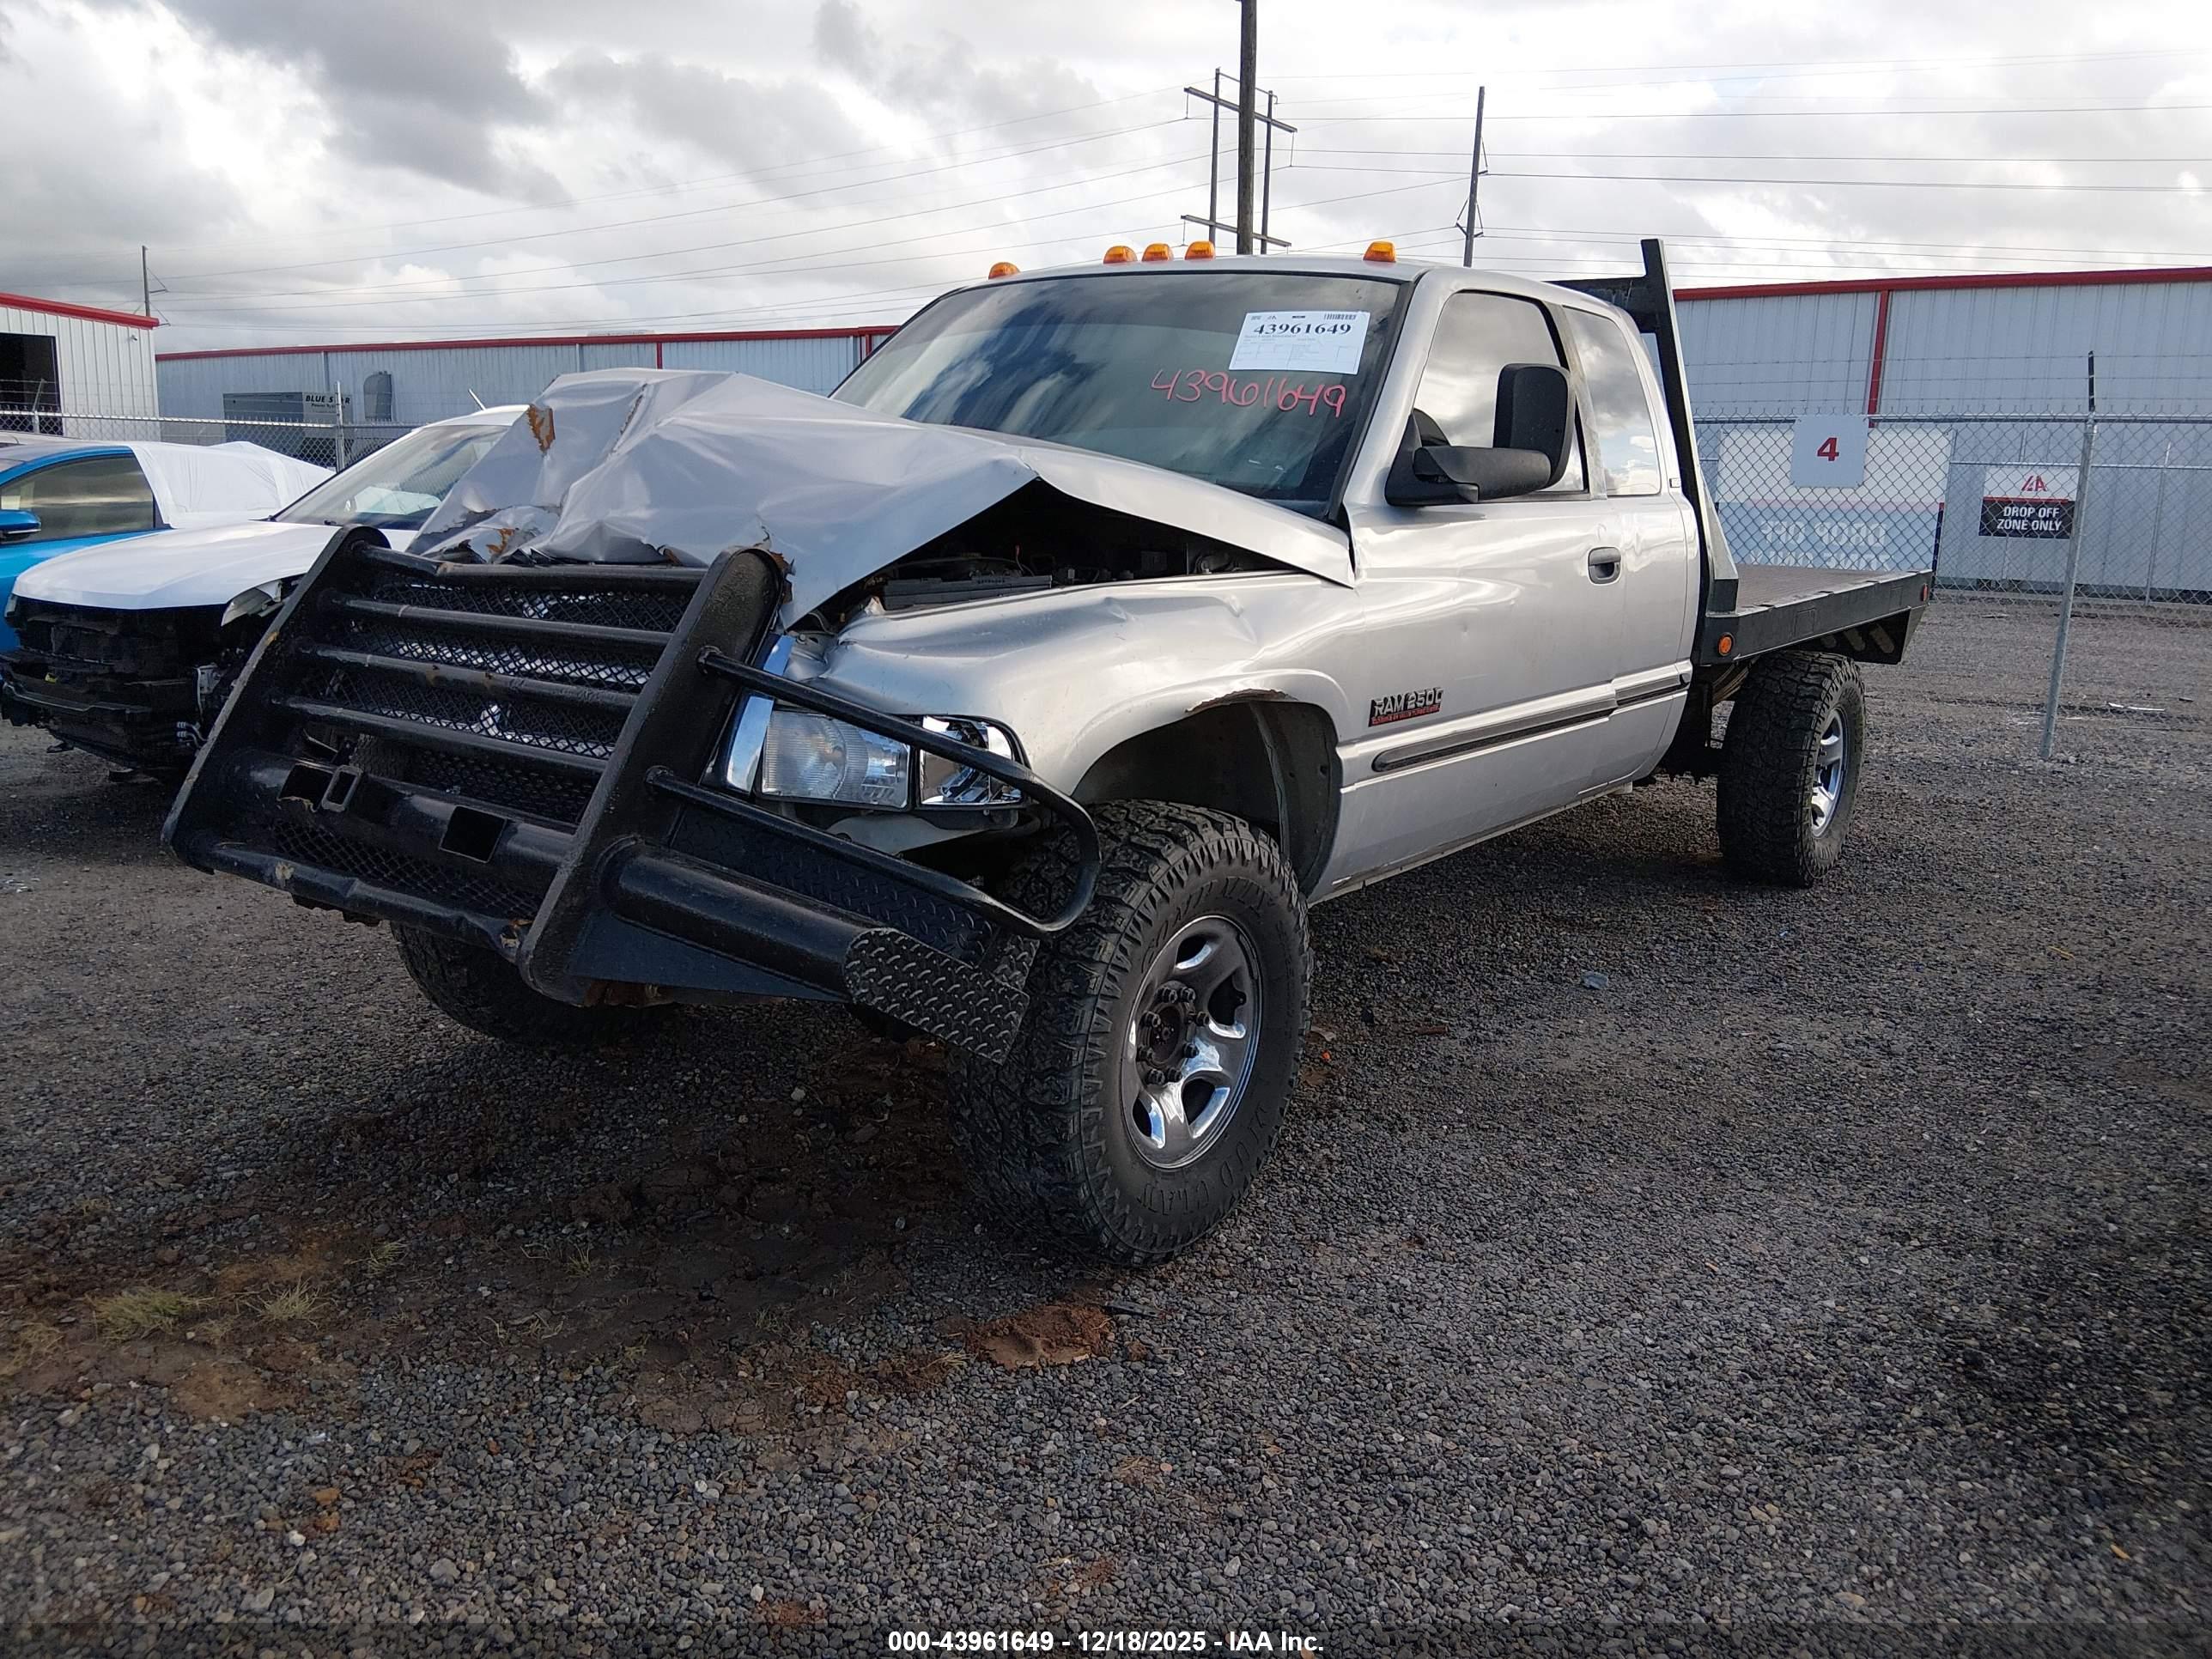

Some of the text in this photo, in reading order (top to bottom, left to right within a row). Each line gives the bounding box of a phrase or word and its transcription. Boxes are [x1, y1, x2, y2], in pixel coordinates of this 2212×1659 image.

[1254, 323, 1352, 335] 43961649
[1151, 368, 1347, 418] 43961649
[1817, 437, 1839, 461] 4
[2003, 506, 2060, 519] DROP OFF
[1996, 519, 2063, 532] ZONE ONLY
[1374, 694, 1405, 716] RAM
